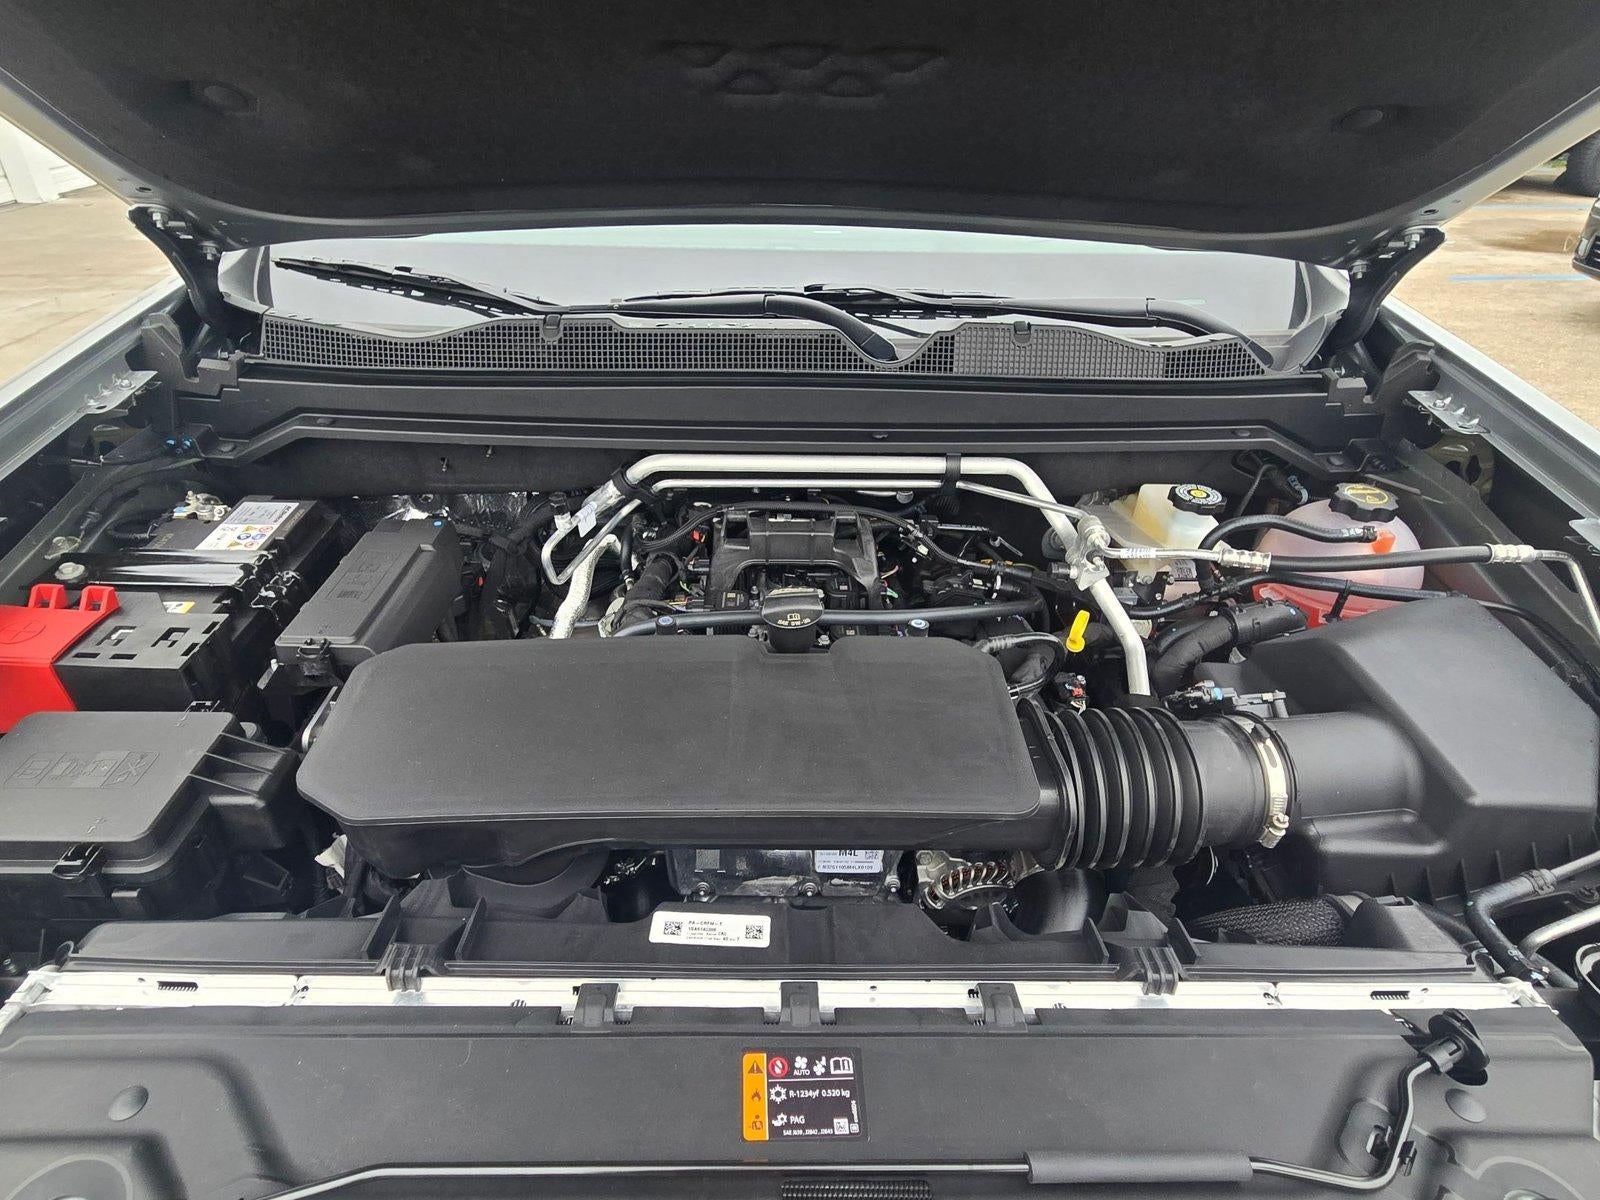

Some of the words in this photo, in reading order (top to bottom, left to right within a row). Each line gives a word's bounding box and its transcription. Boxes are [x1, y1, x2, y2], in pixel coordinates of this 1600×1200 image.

[789, 1089, 819, 1098] R-1234yf
[841, 1089, 850, 1098] kg
[790, 1116, 805, 1124] PAG
